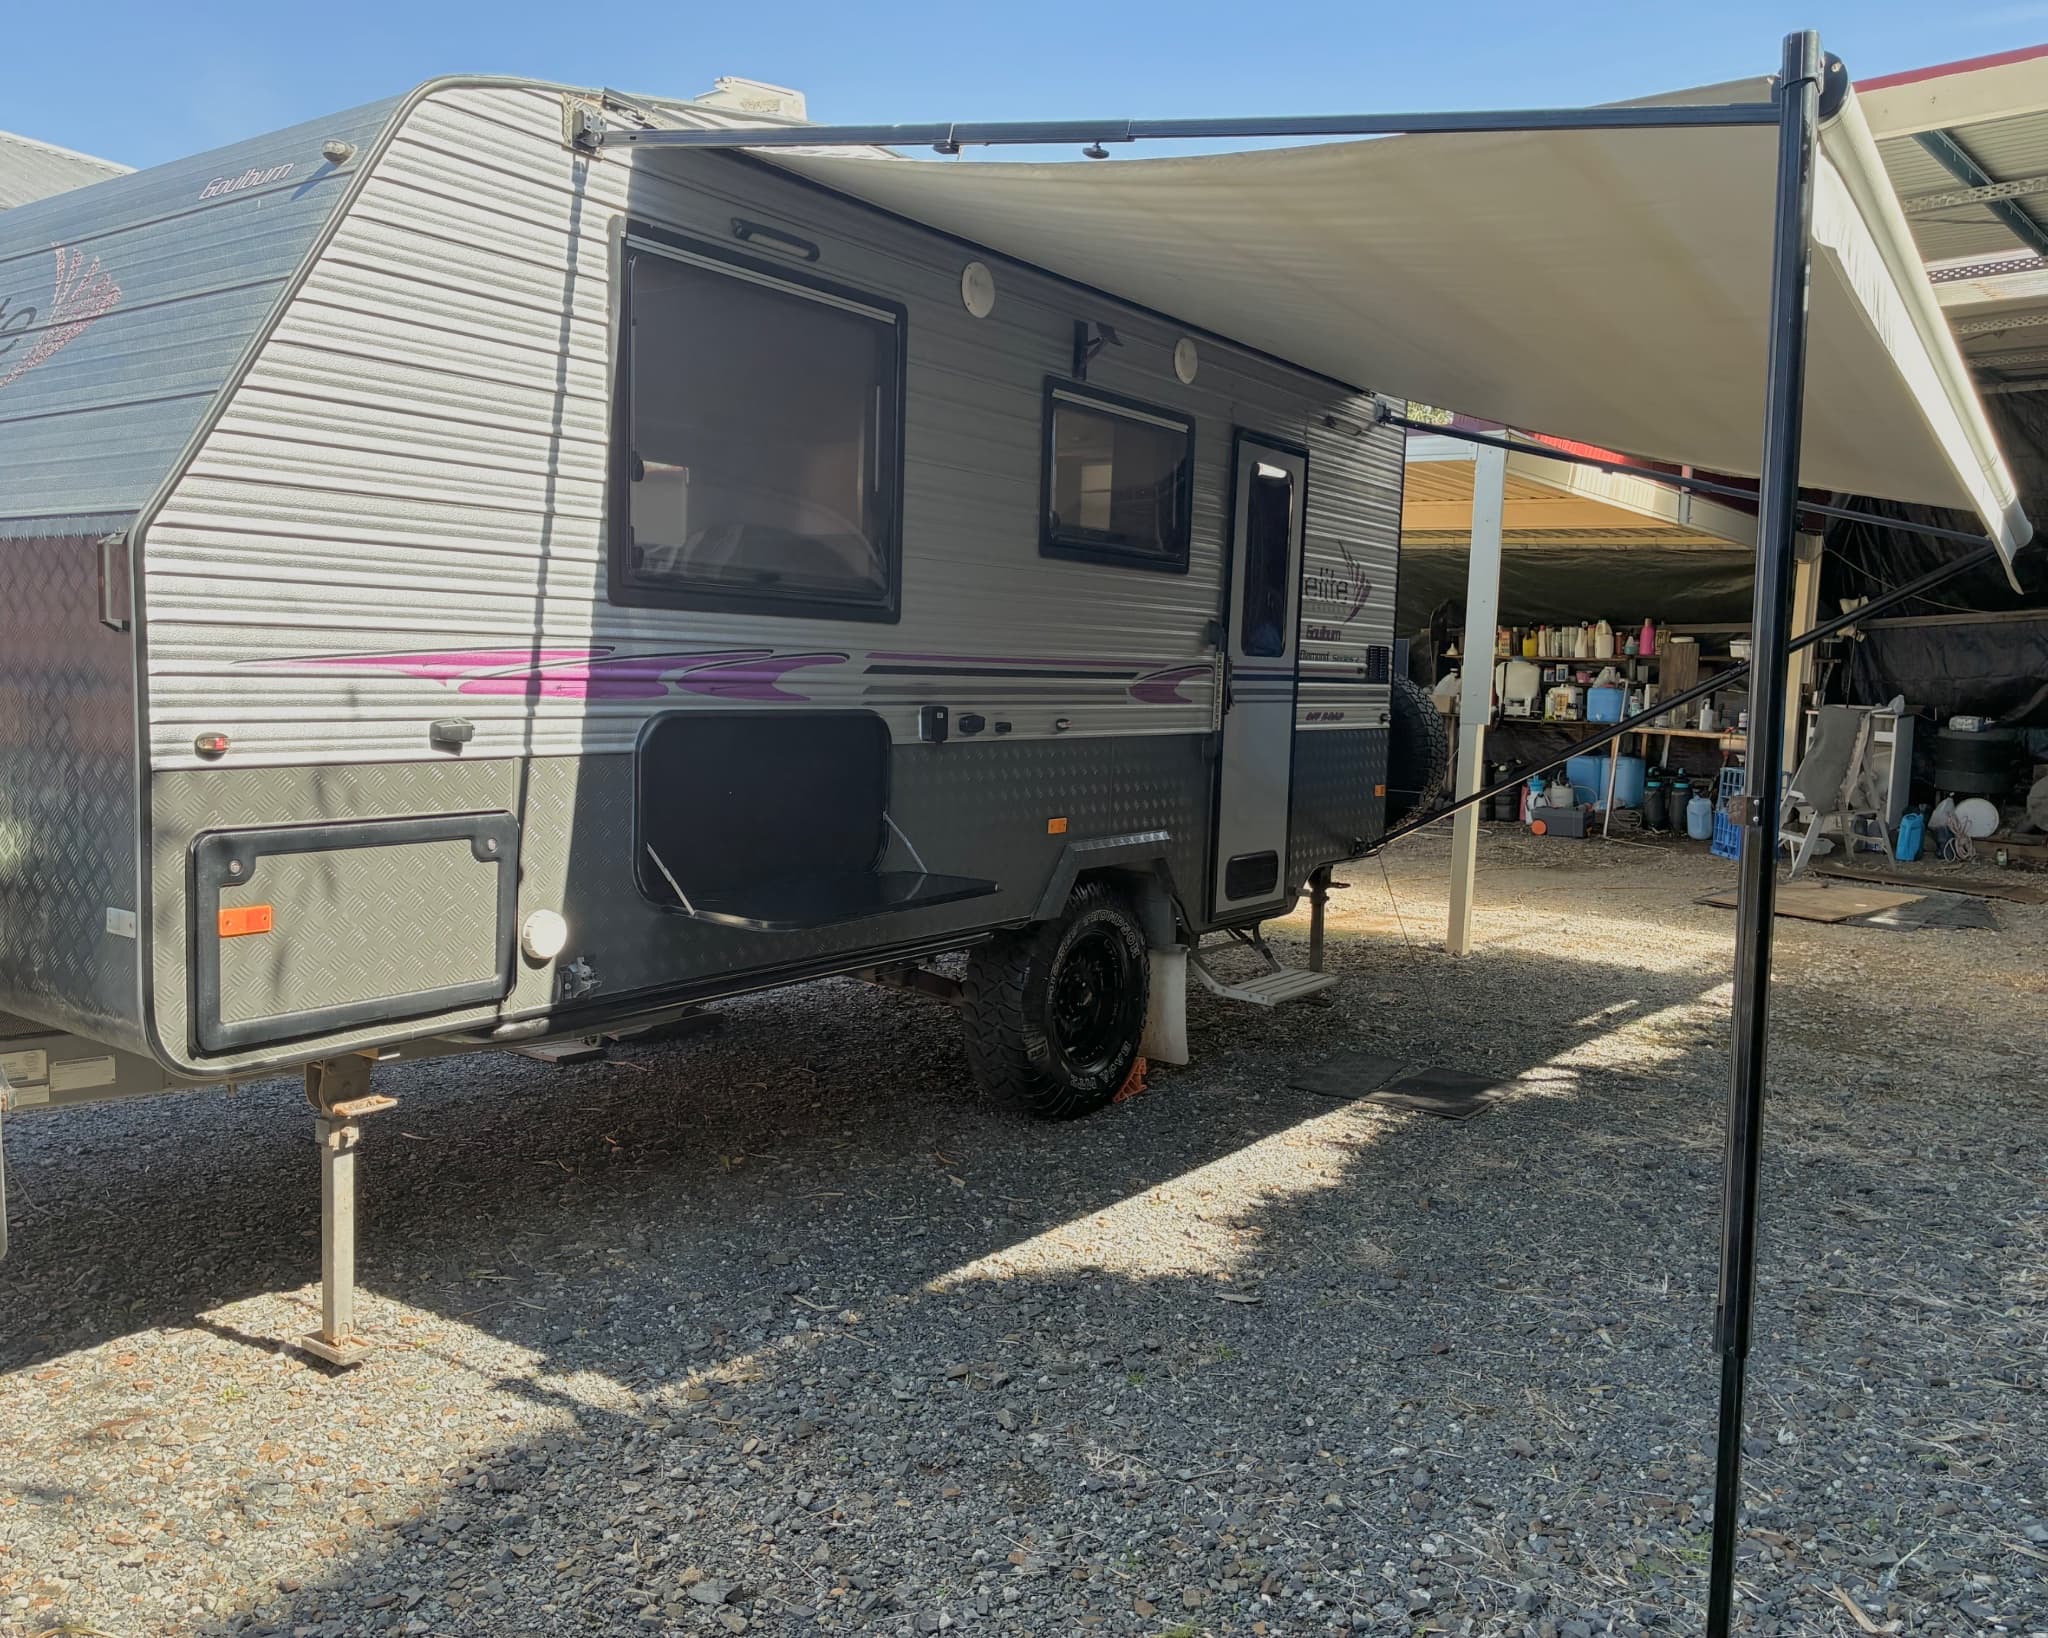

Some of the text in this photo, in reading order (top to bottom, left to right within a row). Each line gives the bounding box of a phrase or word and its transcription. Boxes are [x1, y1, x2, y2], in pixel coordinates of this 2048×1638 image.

[199, 162, 295, 200] Goulburn
[1303, 567, 1349, 604] elite
[1306, 624, 1341, 641] Goulburn
